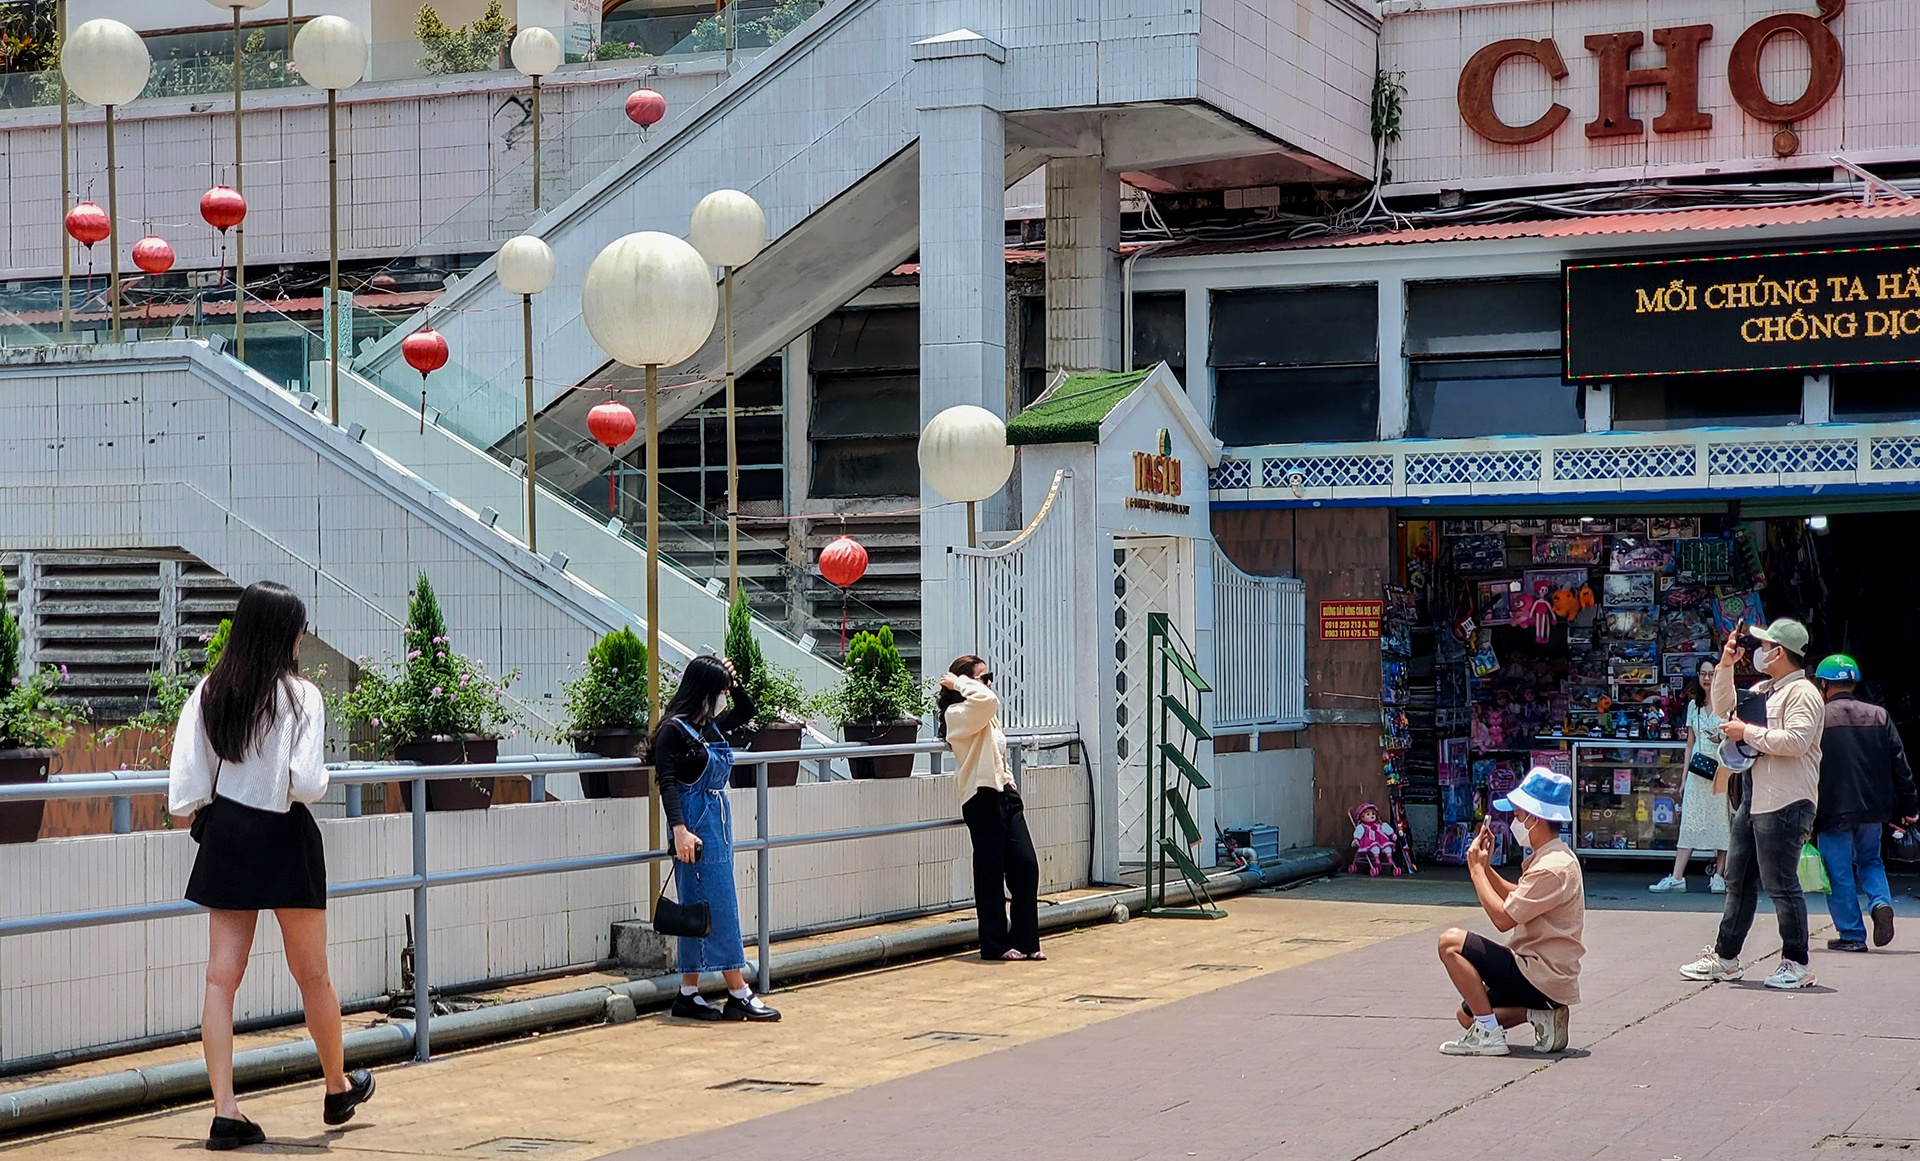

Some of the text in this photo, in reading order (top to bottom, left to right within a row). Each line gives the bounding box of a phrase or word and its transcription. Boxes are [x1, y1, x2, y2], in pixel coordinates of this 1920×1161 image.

[1456, 0, 1846, 157] CHỢ
[1635, 279, 1698, 313] MỖI
[1704, 274, 1820, 309] CHÚNG
[1826, 276, 1869, 302] TA
[1740, 308, 1859, 343] CHỐNG
